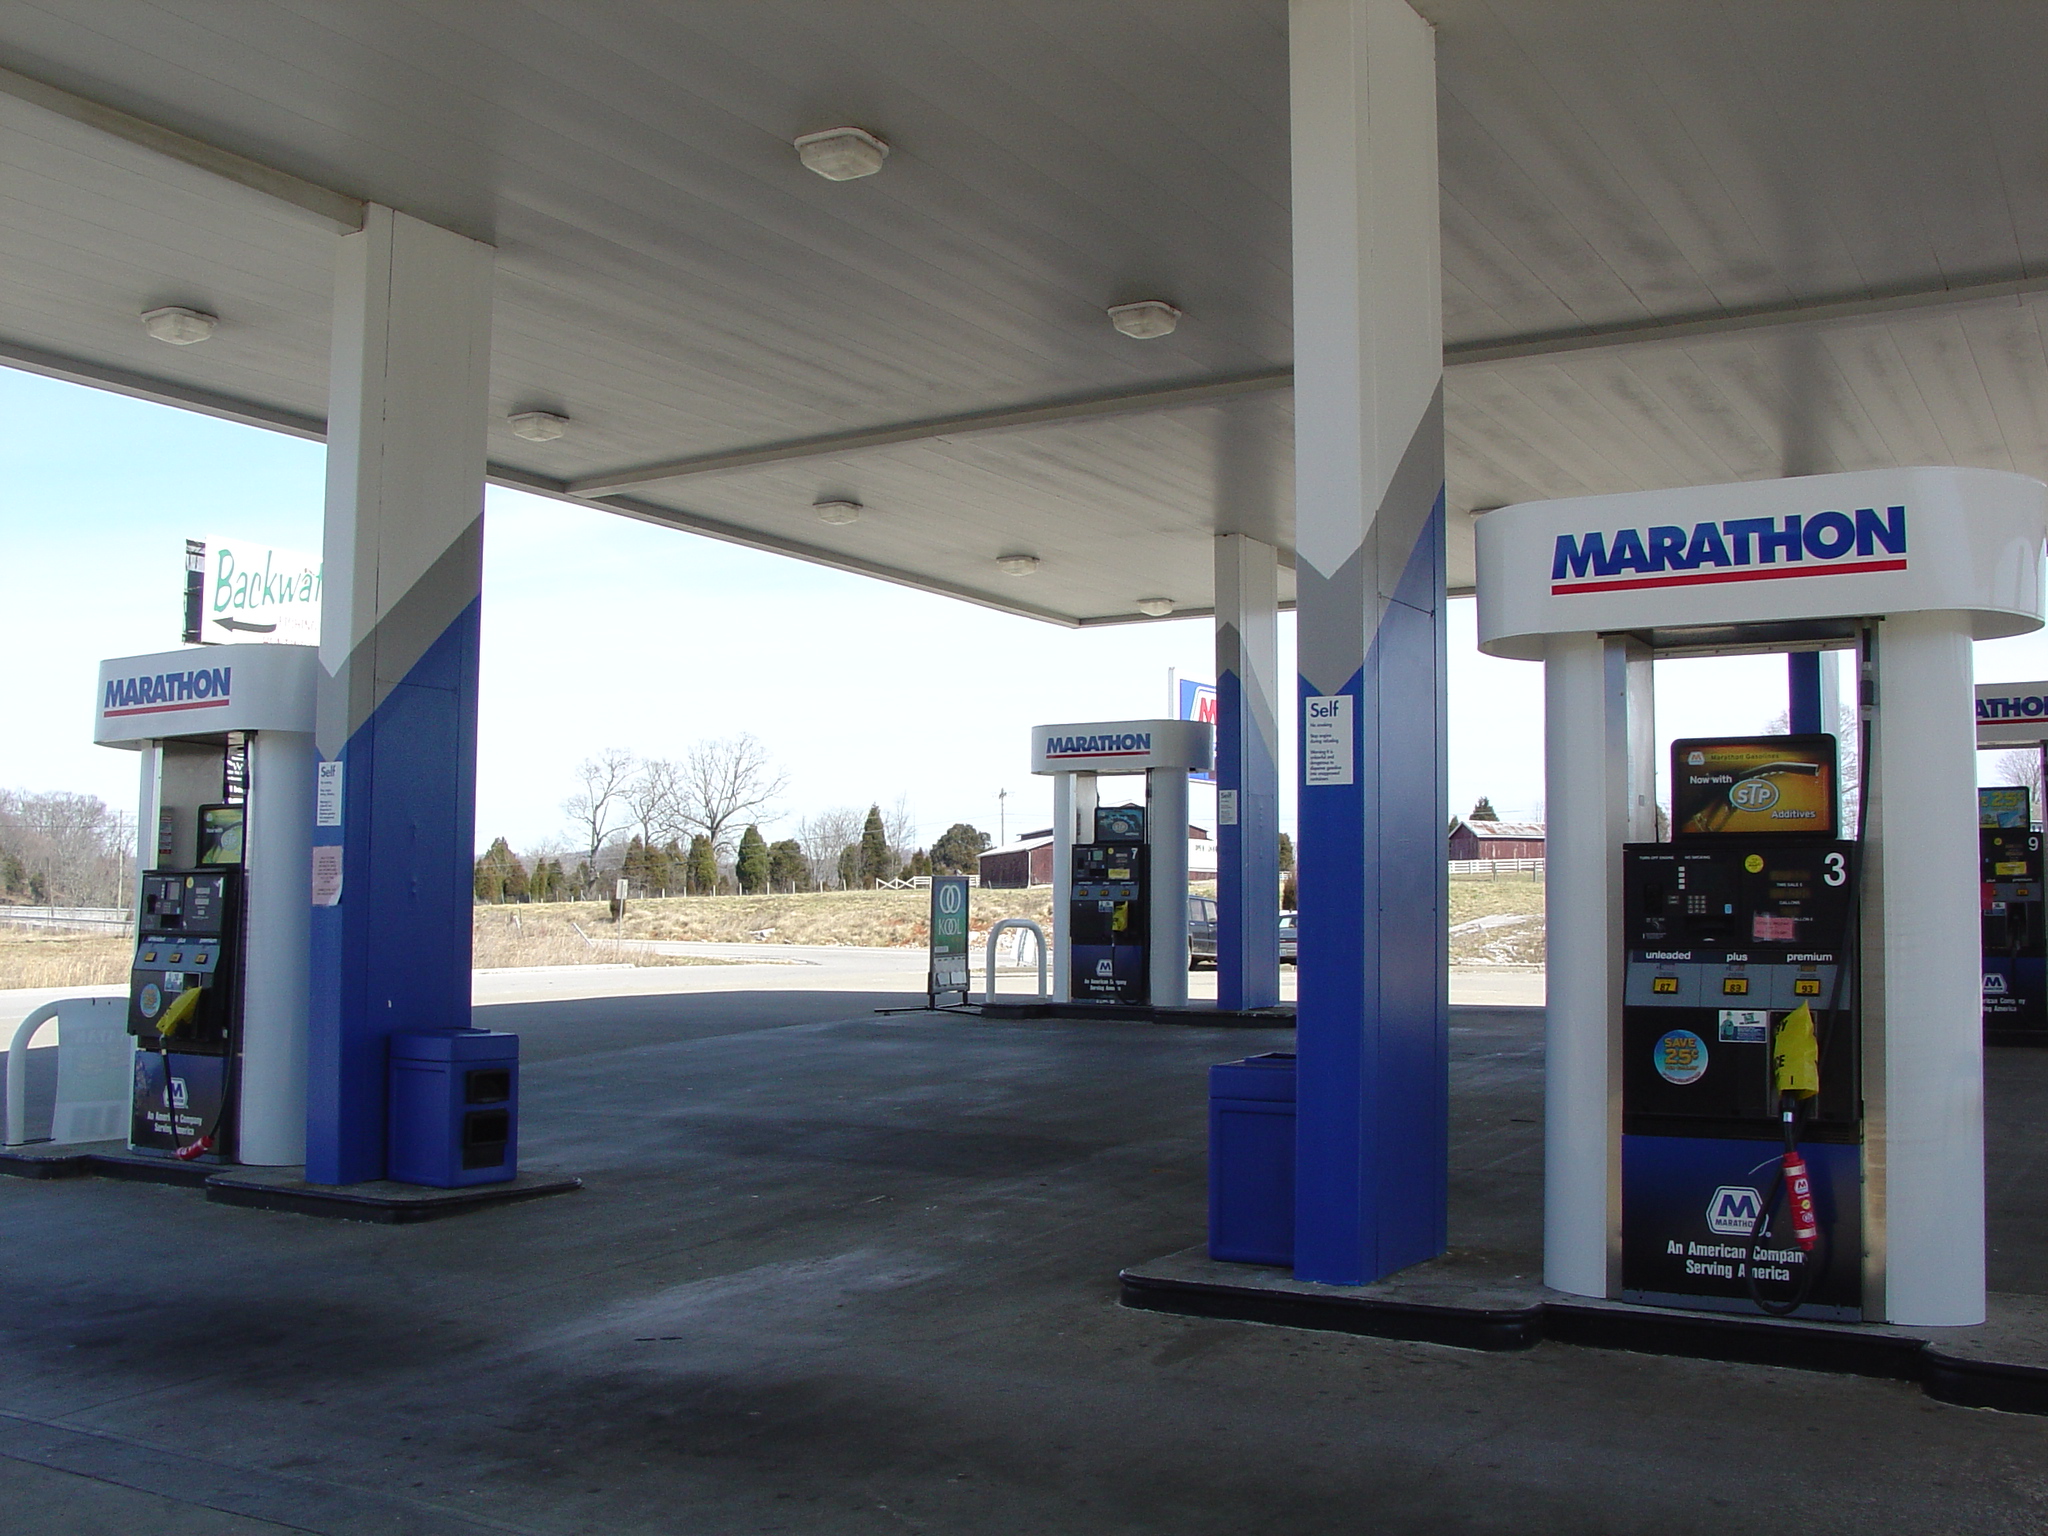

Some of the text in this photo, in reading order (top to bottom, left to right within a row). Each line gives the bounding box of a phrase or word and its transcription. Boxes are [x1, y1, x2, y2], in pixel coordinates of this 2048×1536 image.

[1551, 505, 1906, 580] MARATHON
[104, 667, 231, 709] MARATHON
[1310, 700, 1339, 718] Self
[1046, 733, 1151, 754] MARATHON
[320, 765, 336, 778] Self
[1689, 775, 1733, 784] Now with
[1737, 783, 1771, 806] STP
[1771, 809, 1816, 819] Additives
[2028, 836, 2039, 851] 9
[1131, 847, 1138, 860] 7
[1823, 852, 1846, 887] 3
[213, 877, 224, 898] 1
[938, 918, 962, 936] KOOL
[1645, 951, 1691, 960] unleaded
[1726, 952, 1748, 962] plus
[1786, 952, 1833, 962] premium
[1659, 983, 1671, 992] 87
[1801, 984, 1813, 994] 93
[1664, 1037, 1697, 1048] SAVE
[1718, 1194, 1756, 1218] M
[1715, 1218, 1753, 1228] MARATHO
[1667, 1240, 1684, 1255] An
[1687, 1241, 1747, 1260] American
[1685, 1259, 1733, 1279] Serving
